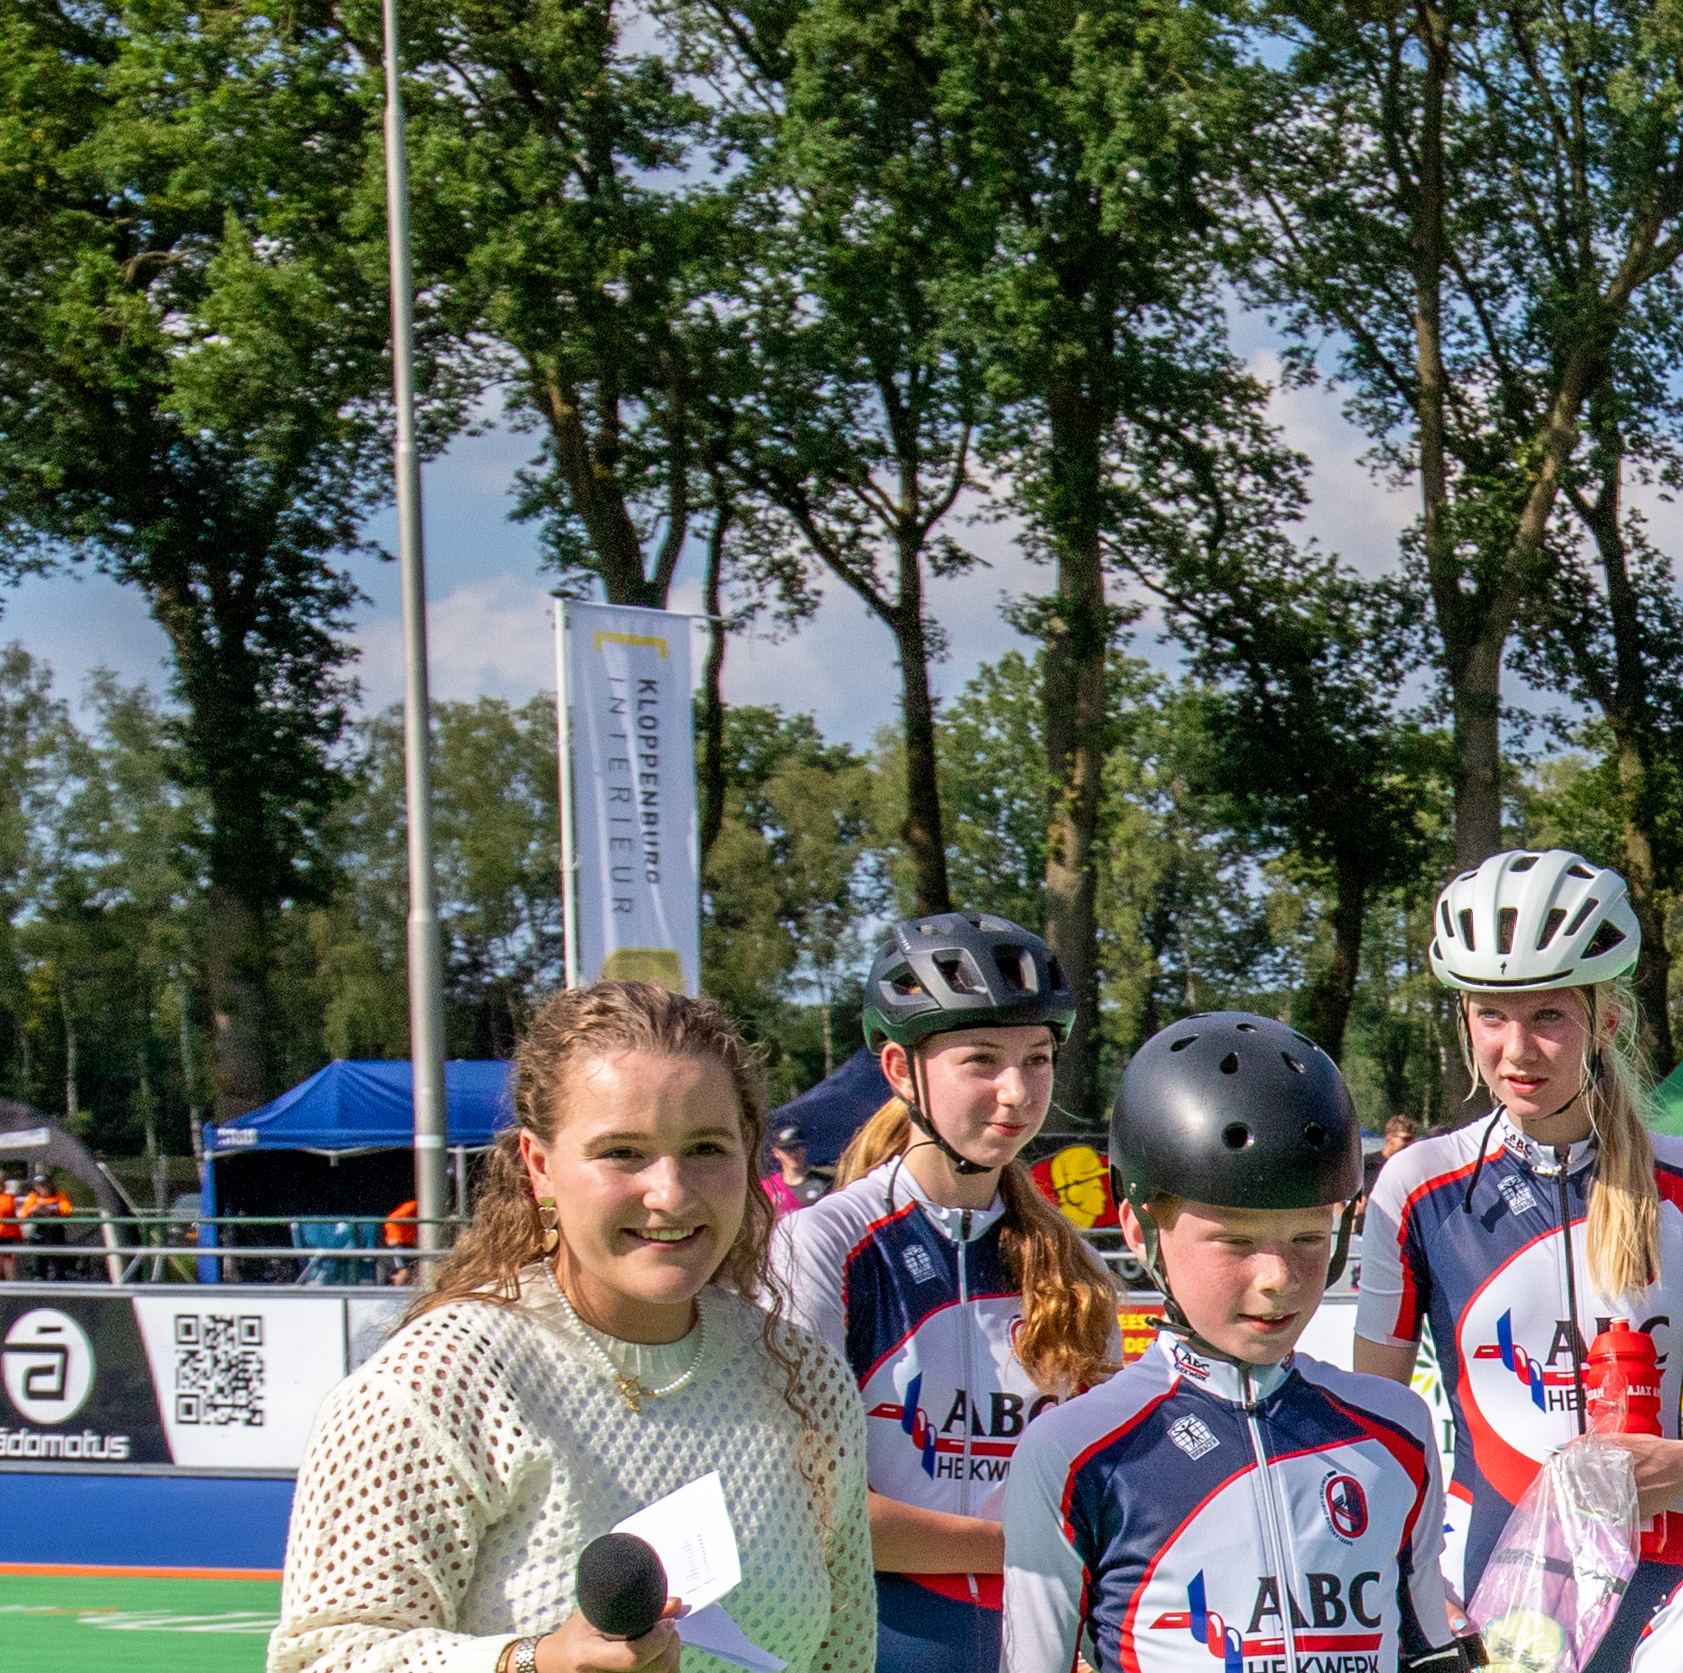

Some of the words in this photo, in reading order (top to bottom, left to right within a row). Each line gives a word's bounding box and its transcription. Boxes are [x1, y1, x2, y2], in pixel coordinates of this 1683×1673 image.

[607, 676, 635, 915] INTERIEUR
[637, 678, 662, 885] KLOPPENBURG
[936, 1456, 1011, 1482] HEKW
[1246, 1570, 1383, 1634] ABC
